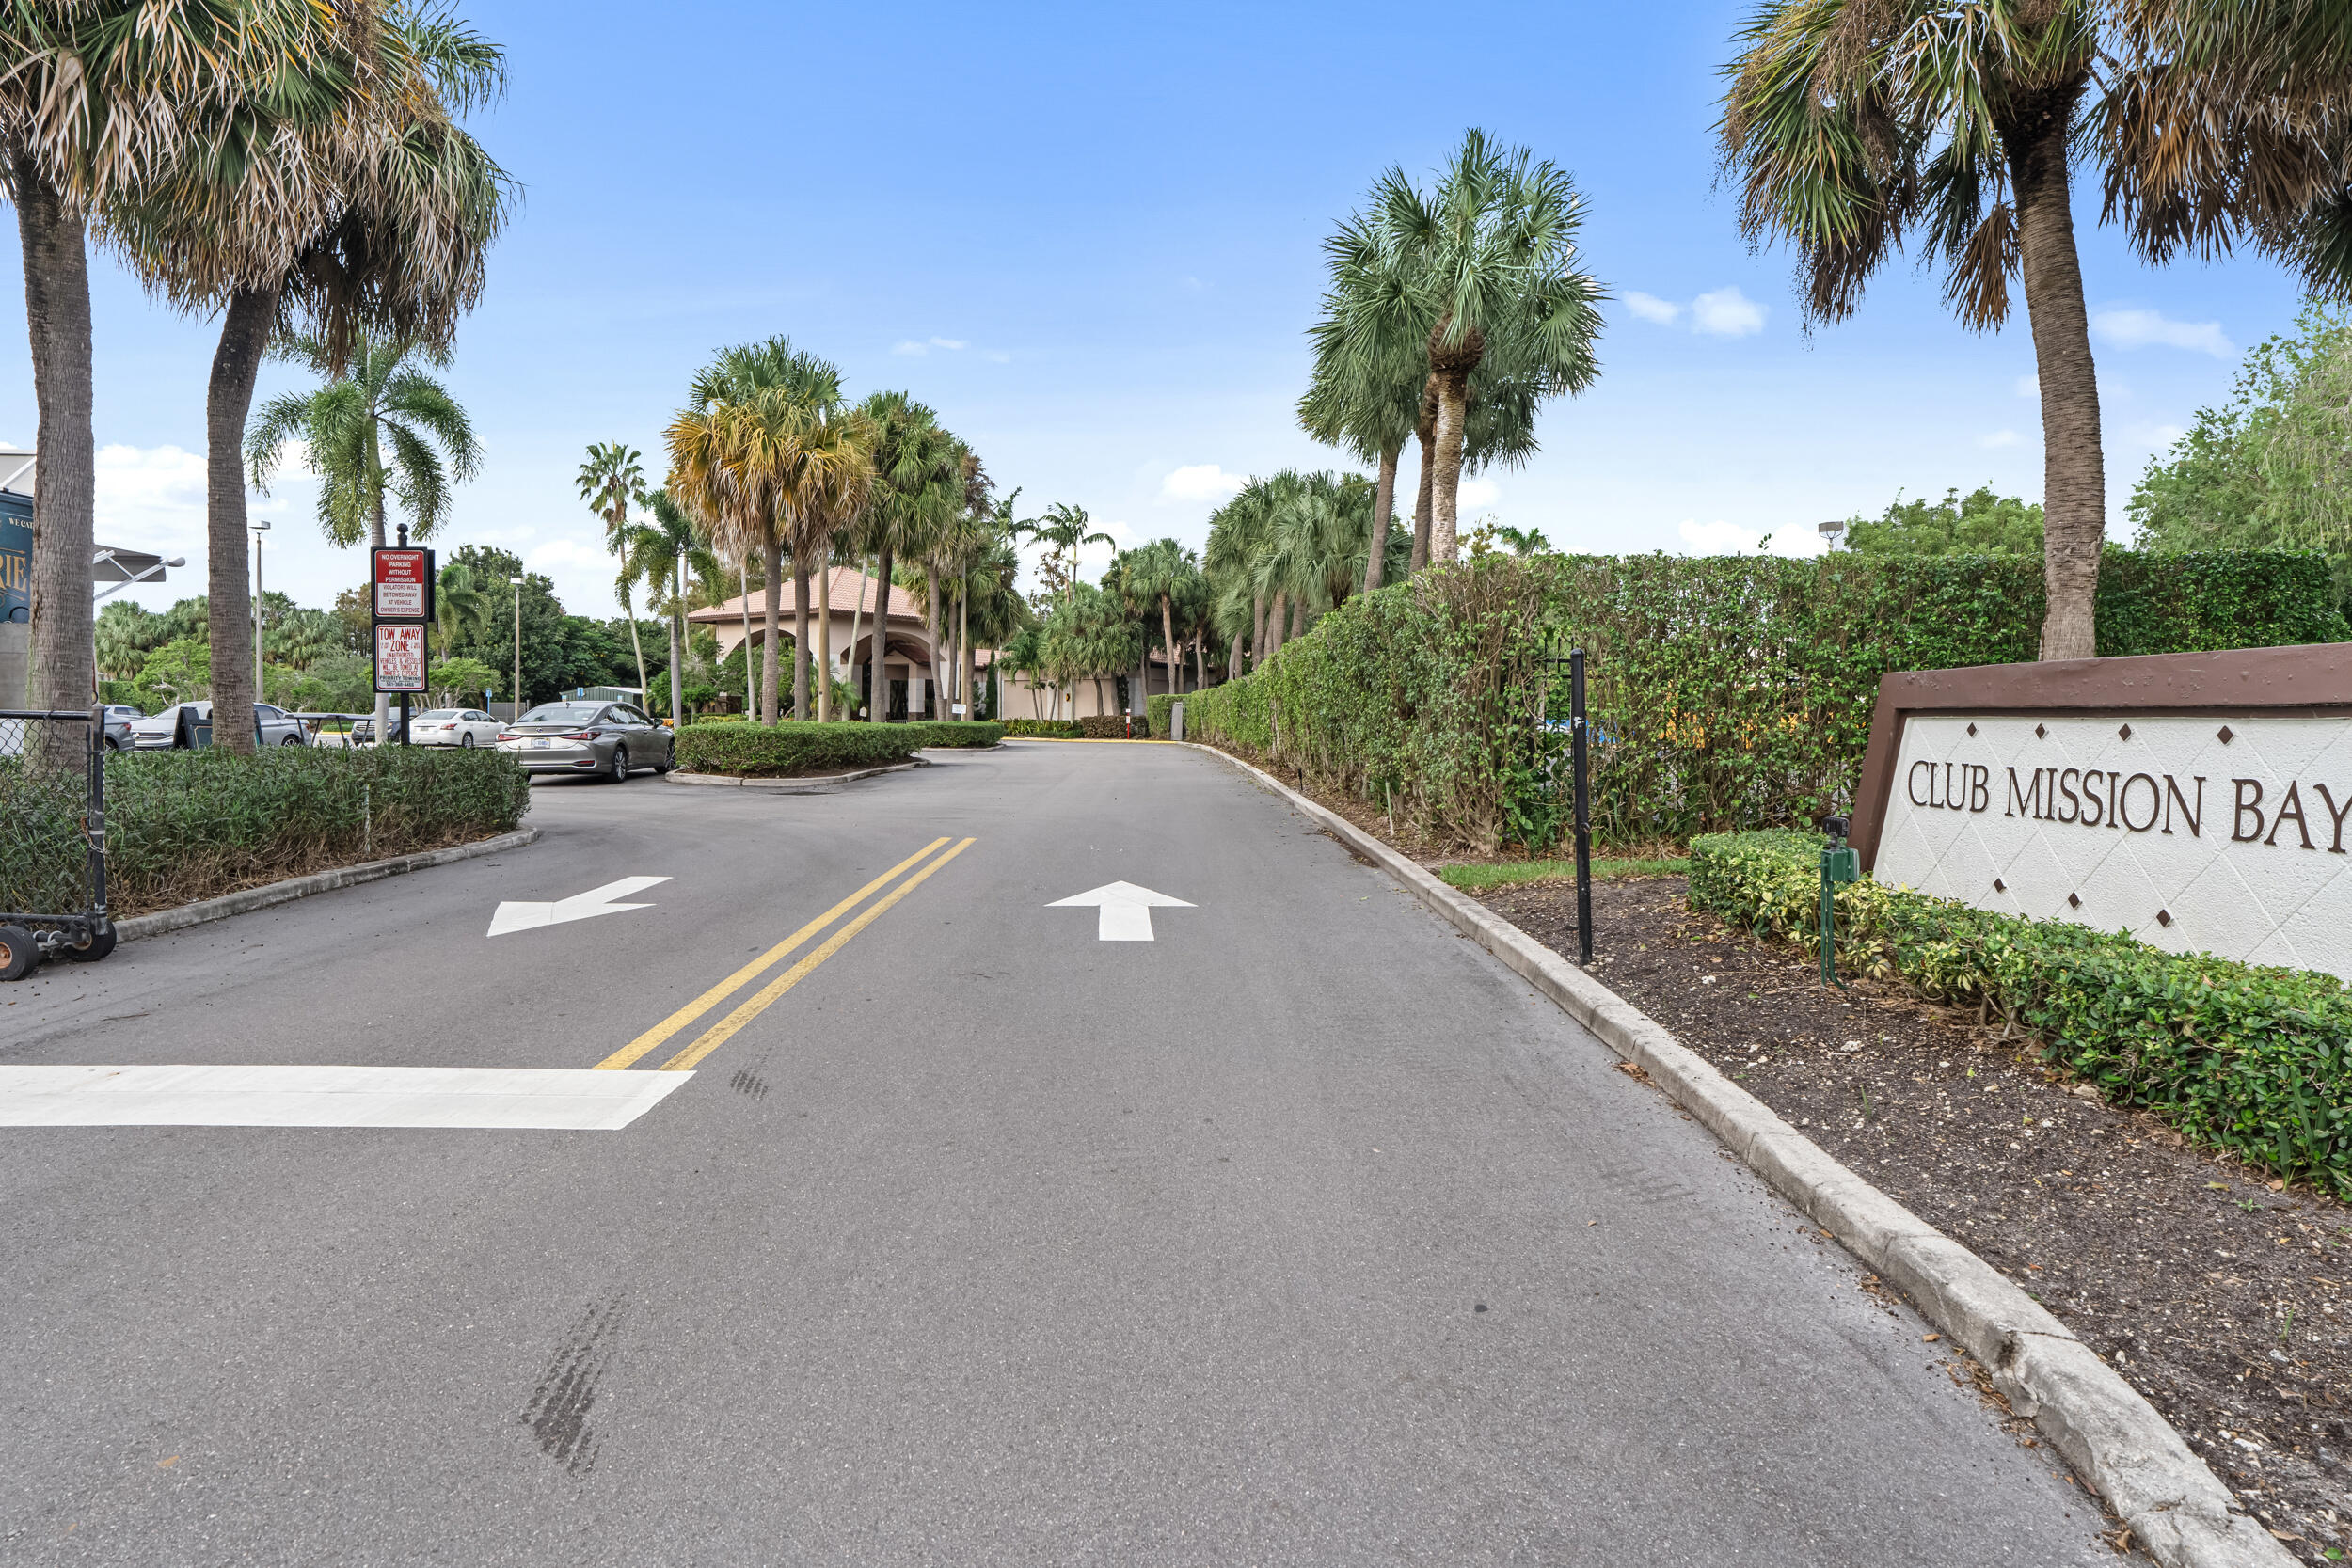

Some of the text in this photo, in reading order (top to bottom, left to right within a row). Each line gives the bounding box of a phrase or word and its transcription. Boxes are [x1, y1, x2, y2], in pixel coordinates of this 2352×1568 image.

[380, 628, 420, 640] TOW AWAY
[390, 640, 410, 651] ZONE
[1908, 760, 2352, 853] CLUB MISSION BAY
